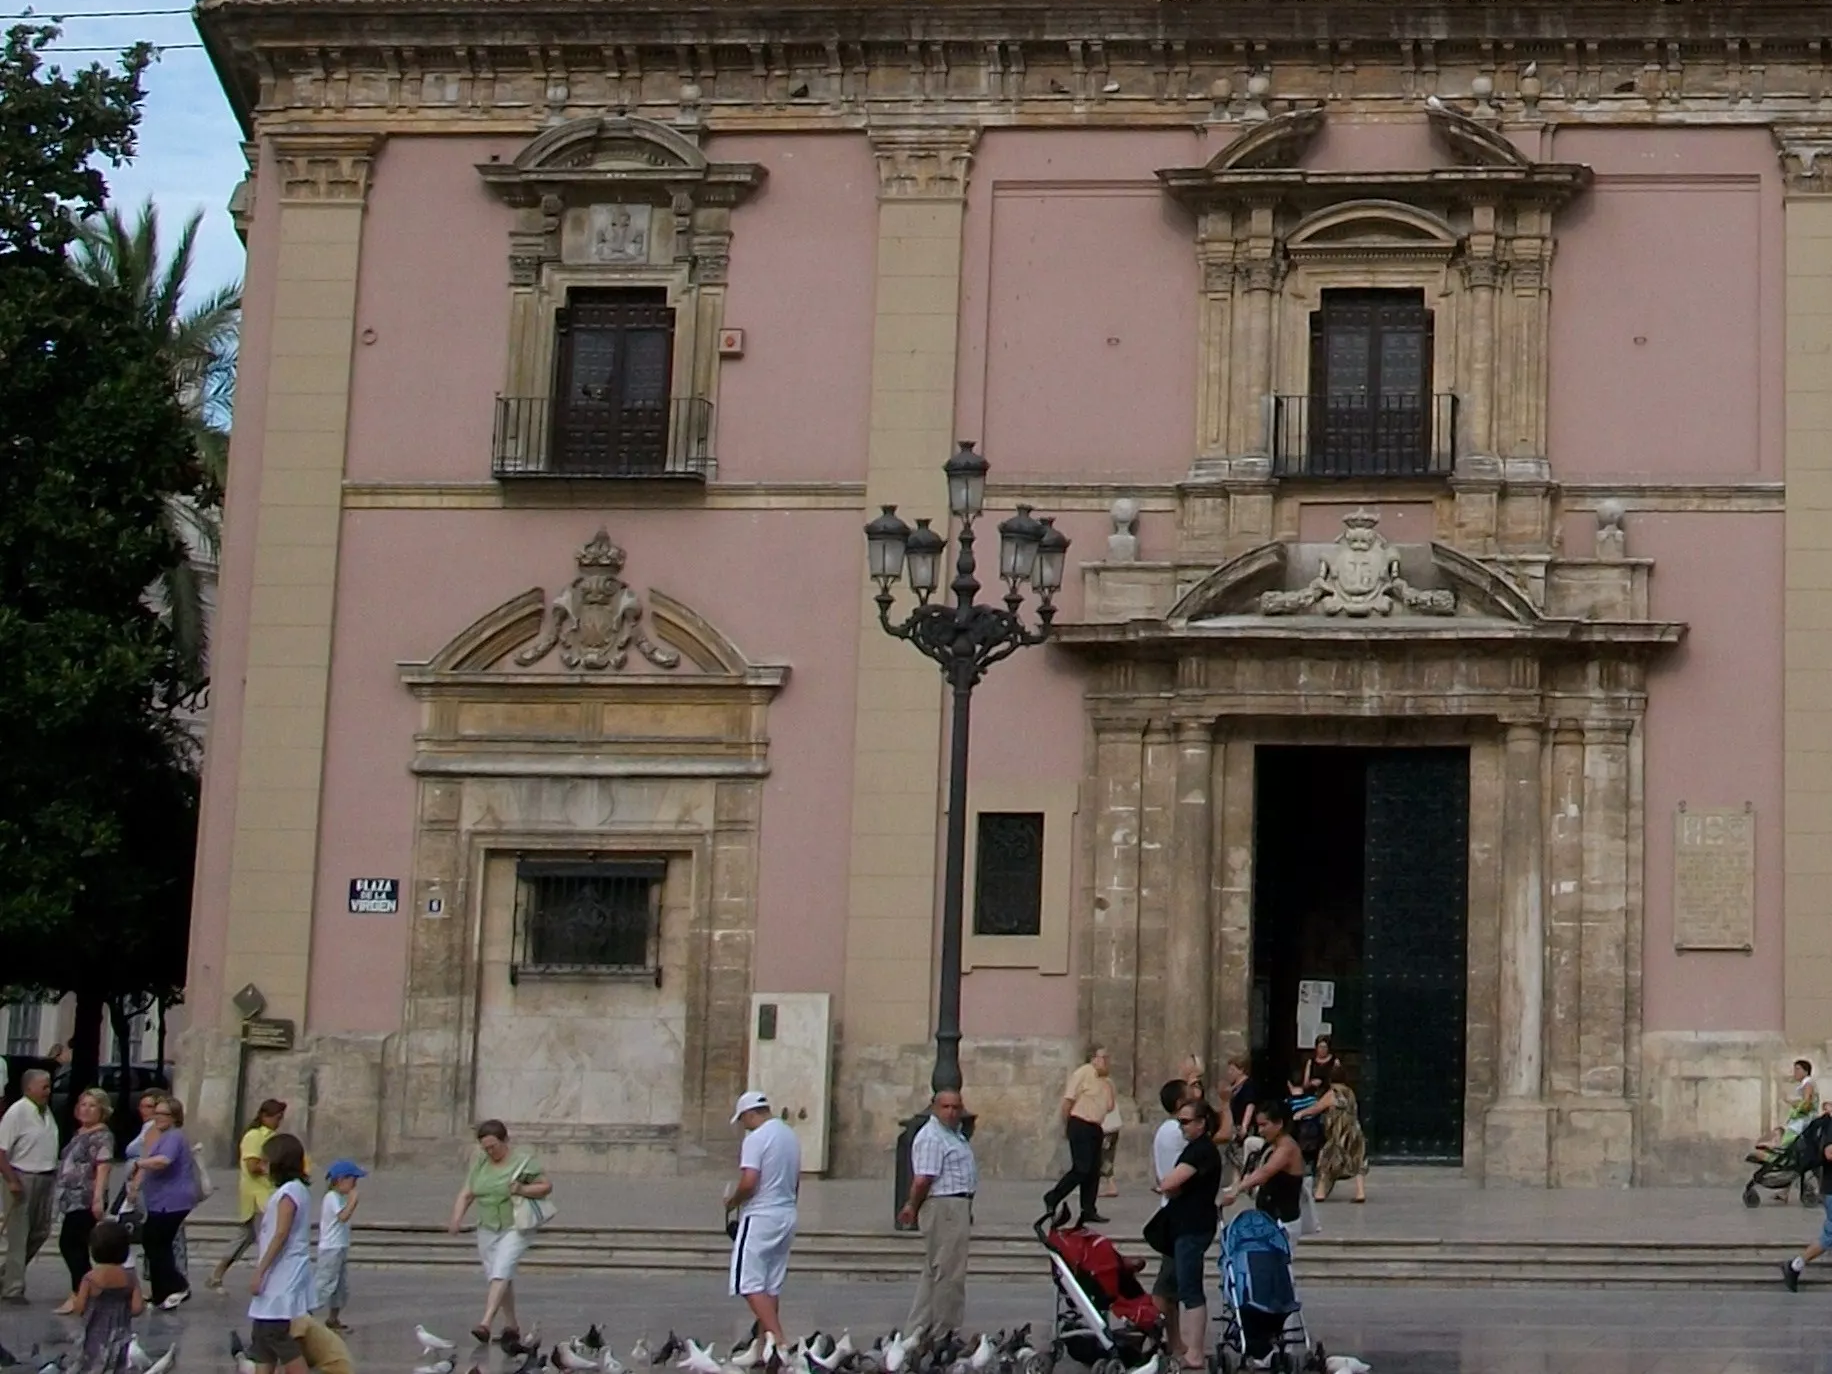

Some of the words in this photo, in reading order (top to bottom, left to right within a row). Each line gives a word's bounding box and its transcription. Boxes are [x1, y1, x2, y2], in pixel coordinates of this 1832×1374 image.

[356, 879, 392, 891] PLAZA
[360, 891, 372, 899] DE
[374, 891, 386, 899] LA
[351, 899, 397, 911] VIRGEN
